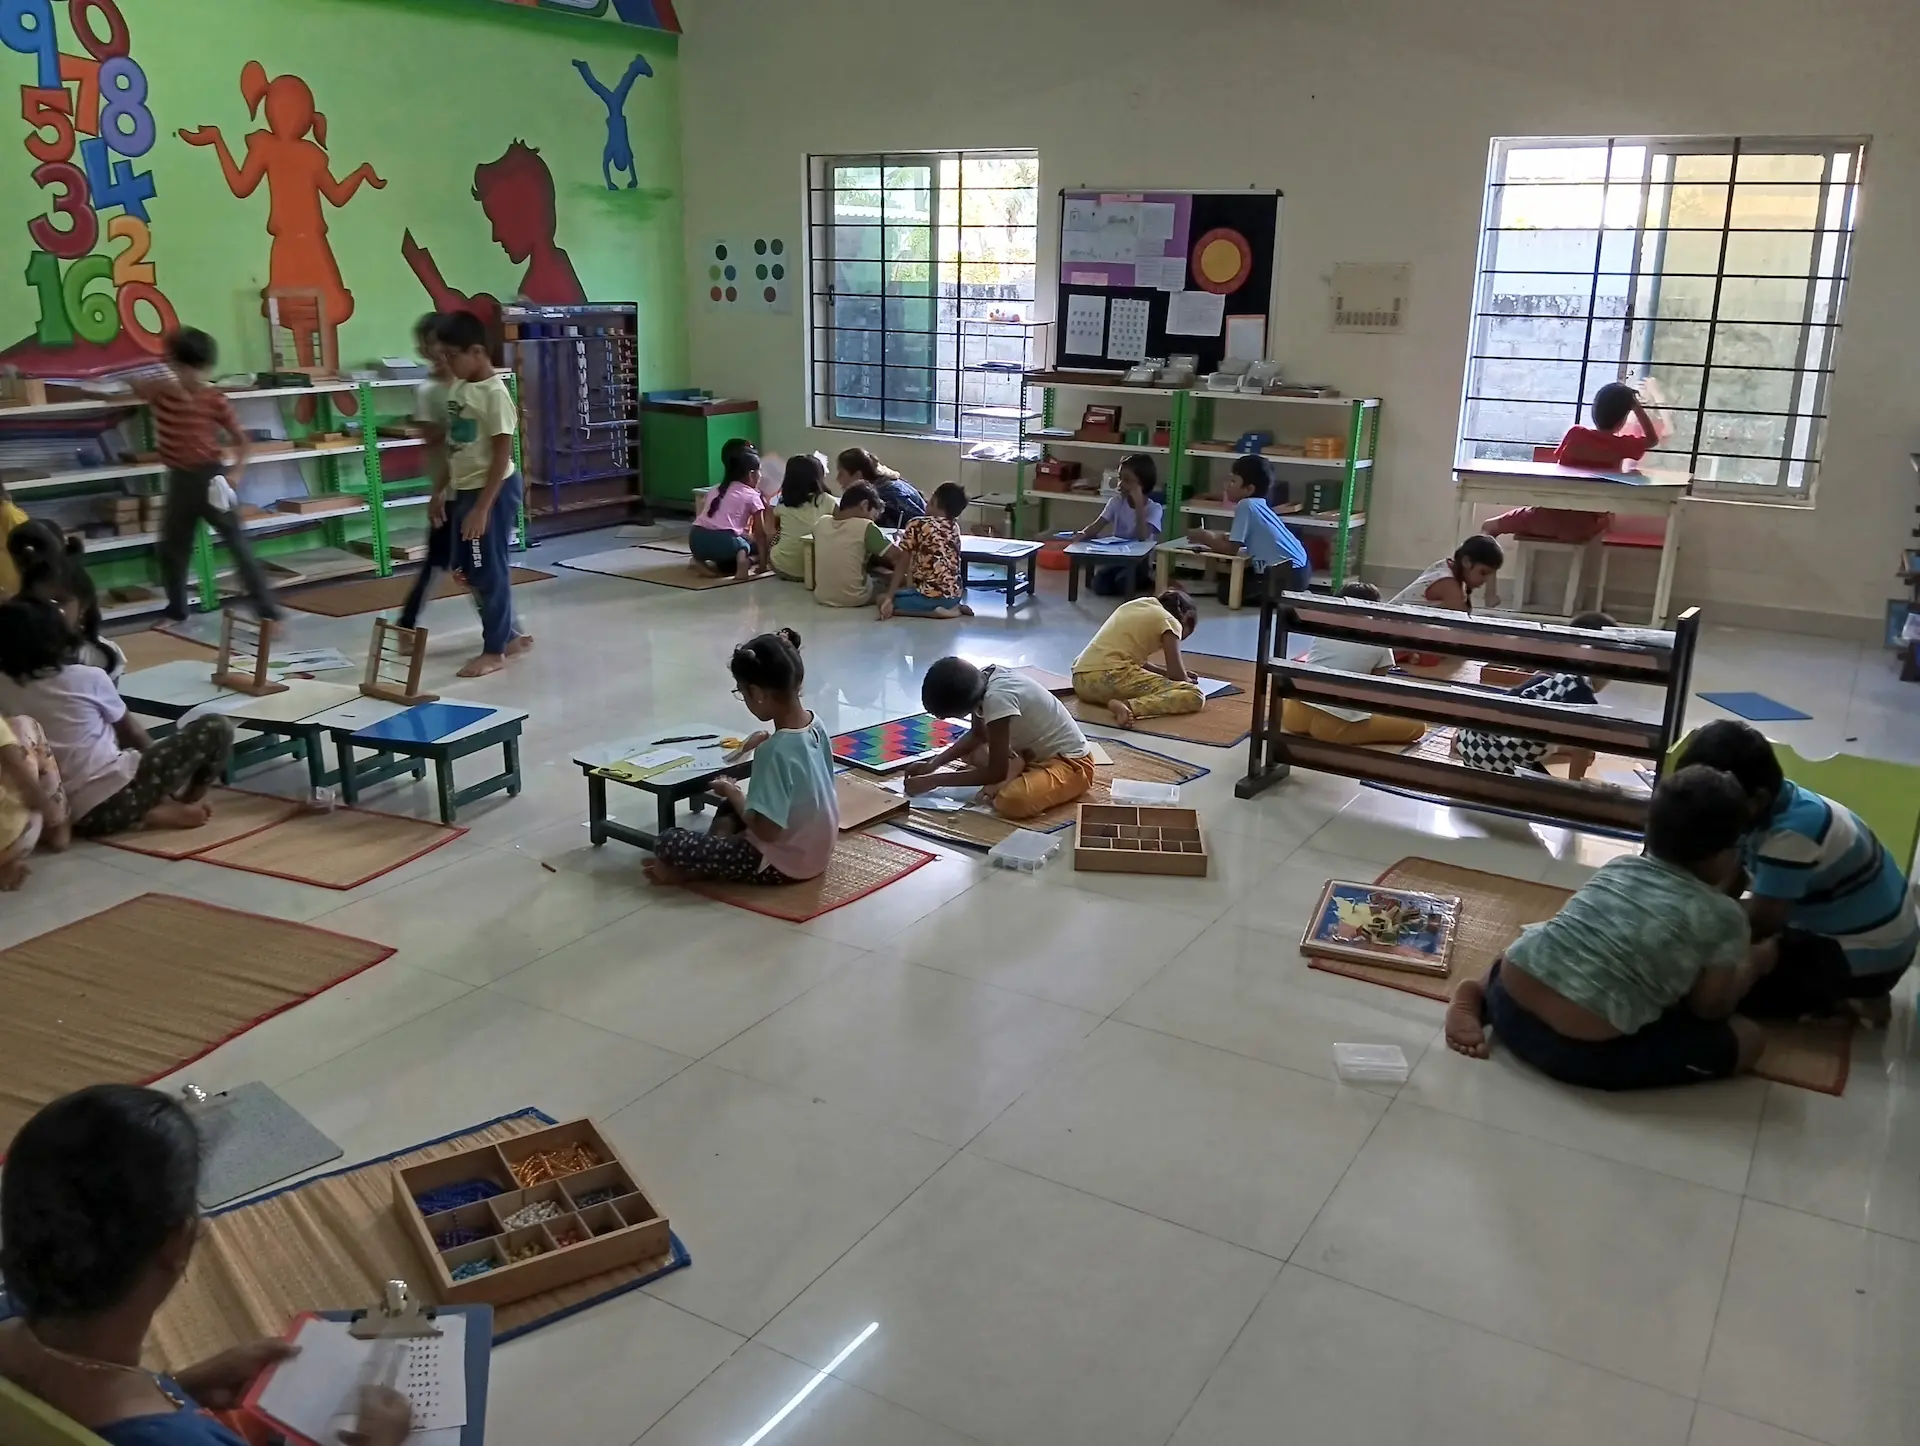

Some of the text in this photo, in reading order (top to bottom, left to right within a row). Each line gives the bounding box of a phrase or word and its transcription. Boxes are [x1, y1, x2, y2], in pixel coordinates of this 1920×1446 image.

[0, 0, 131, 88] 9 0
[20, 85, 157, 223] 5 4
[58, 52, 156, 158] 7 8
[27, 161, 157, 287] 3 2
